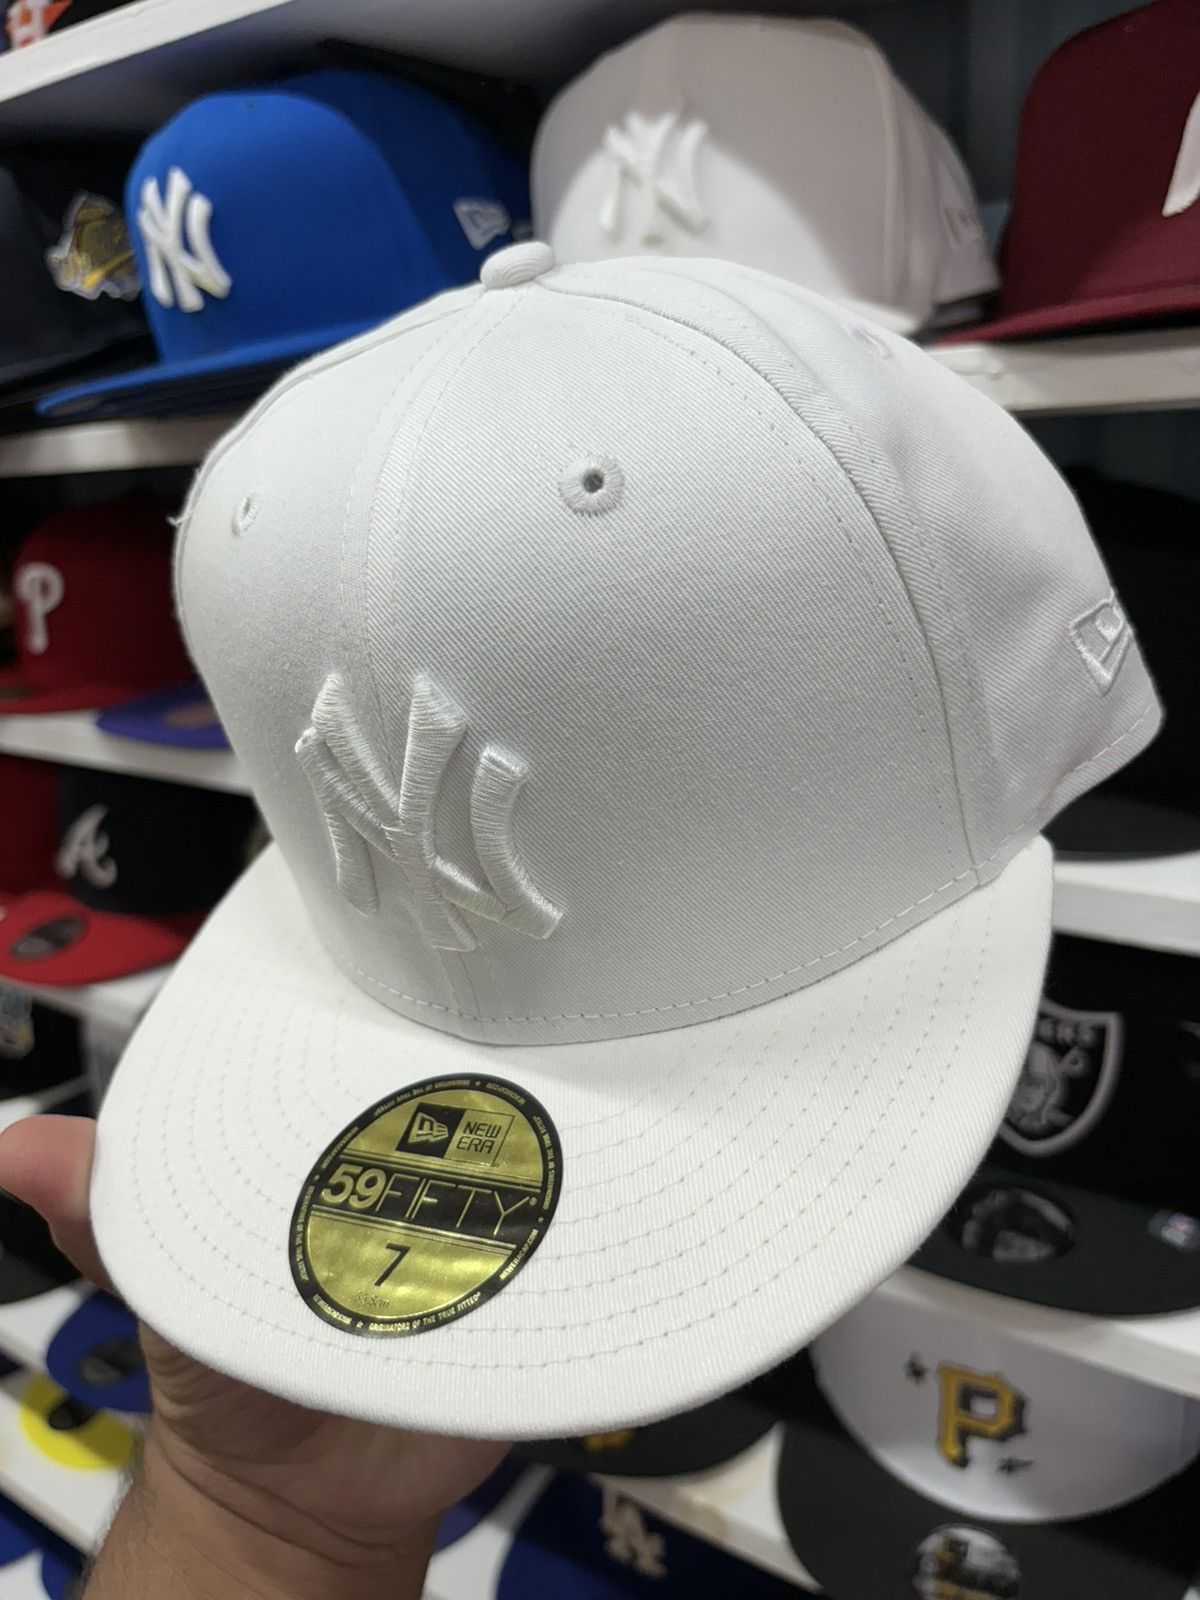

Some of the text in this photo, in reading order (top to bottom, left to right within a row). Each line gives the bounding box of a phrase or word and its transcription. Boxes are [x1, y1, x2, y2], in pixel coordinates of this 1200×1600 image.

[137, 166, 232, 312] NY
[15, 561, 66, 655] P
[295, 673, 564, 952] NY
[456, 1137, 495, 1154] ERA
[463, 1121, 502, 1139] NEW
[374, 1242, 411, 1287] 7
[936, 1361, 1028, 1468] P
